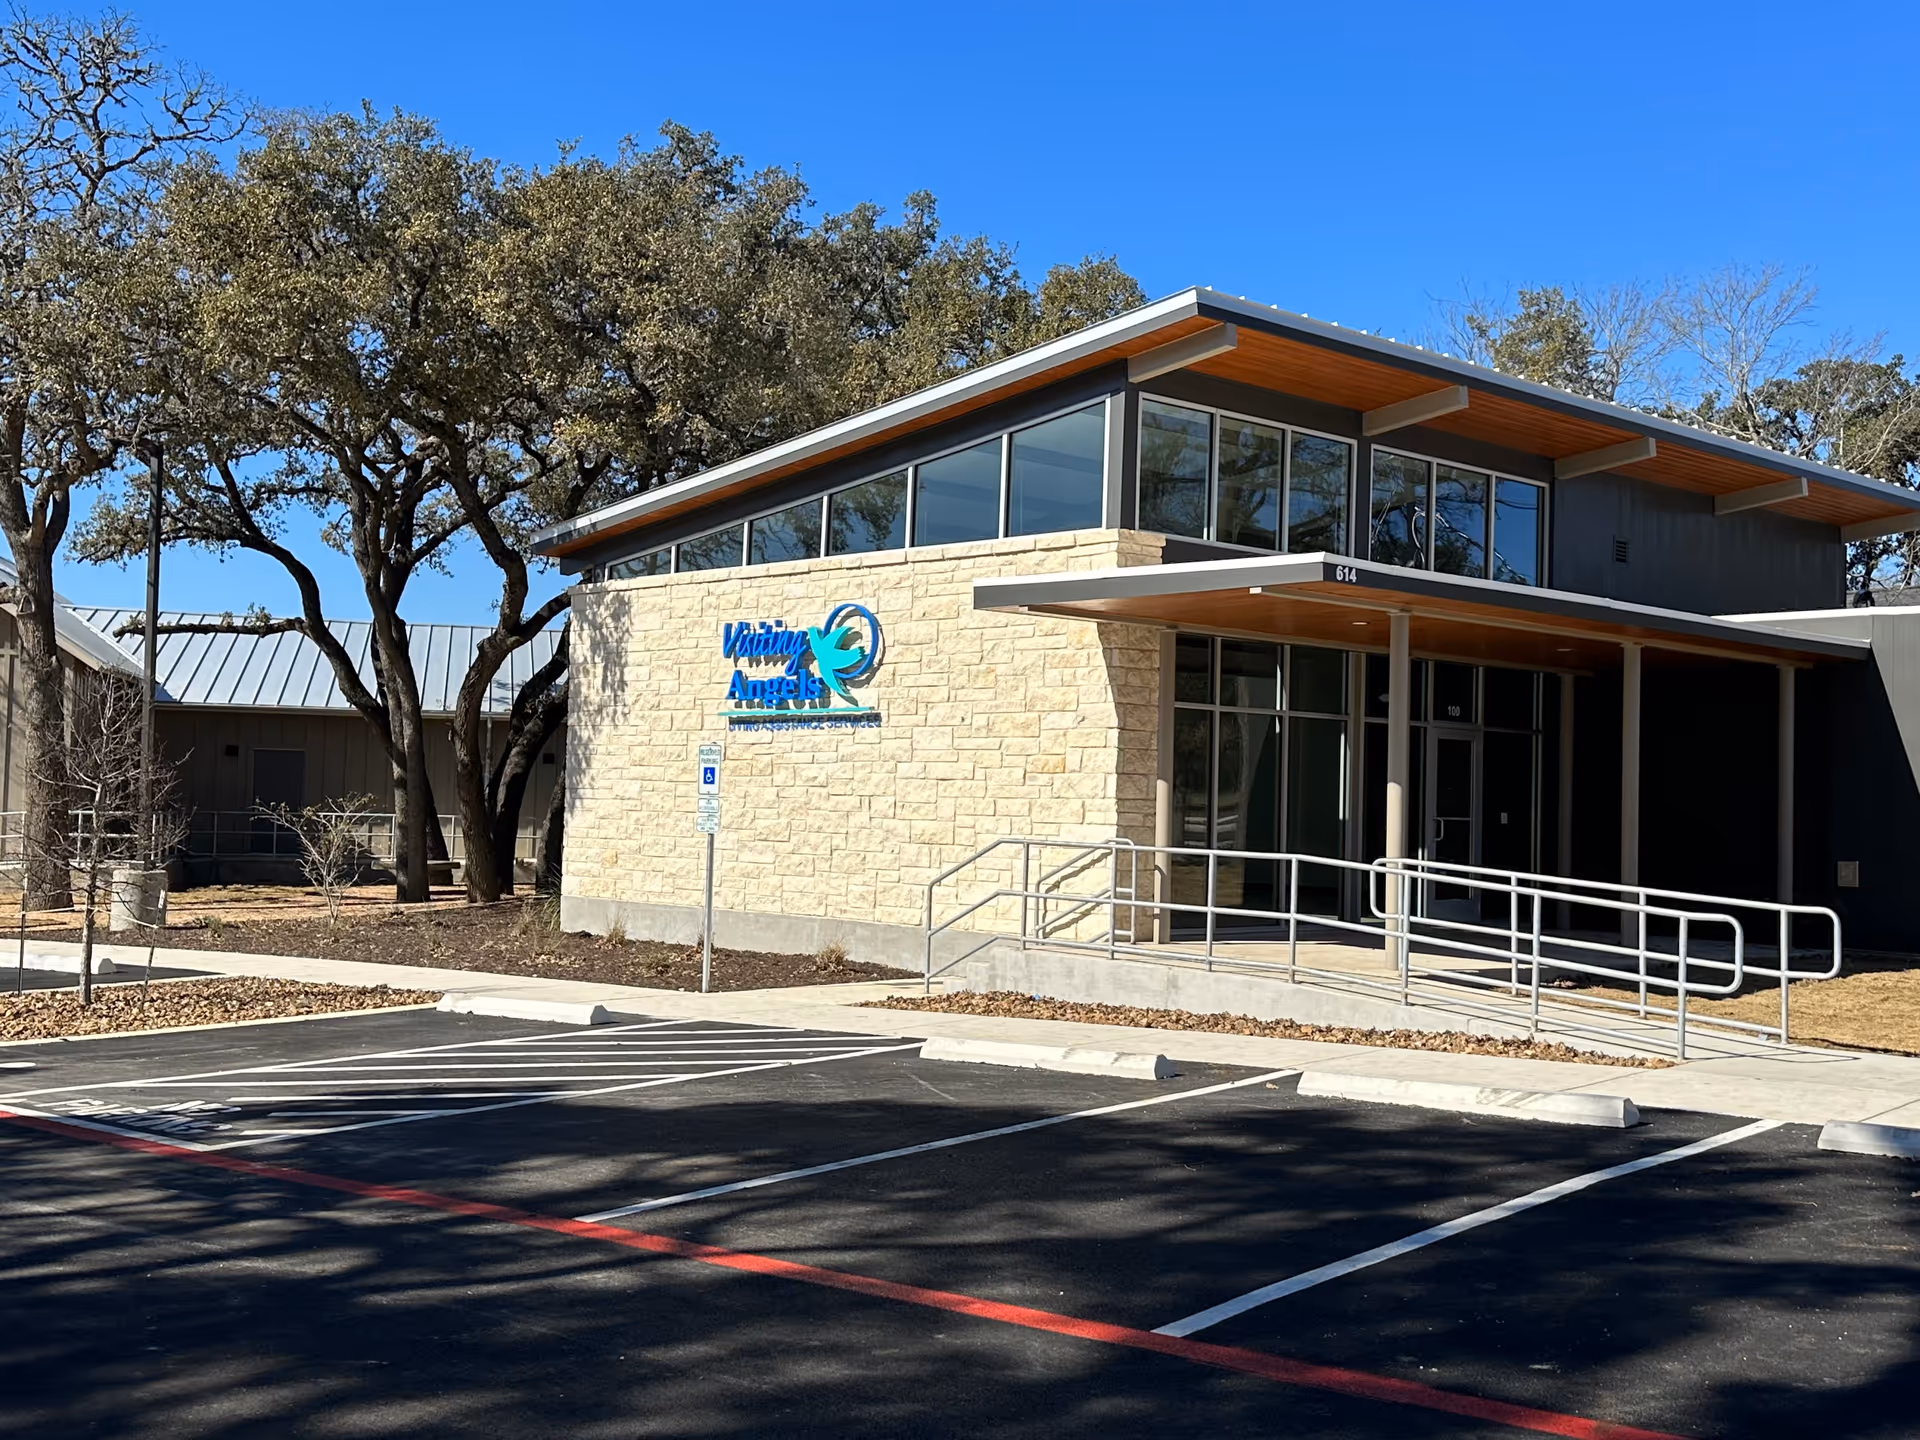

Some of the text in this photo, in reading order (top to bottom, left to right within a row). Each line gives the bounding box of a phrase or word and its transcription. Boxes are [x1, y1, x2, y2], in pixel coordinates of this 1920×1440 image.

[1336, 566, 1357, 583] 614
[723, 620, 807, 676] Visiting
[725, 669, 823, 706] Angels
[1447, 705, 1461, 717] 100
